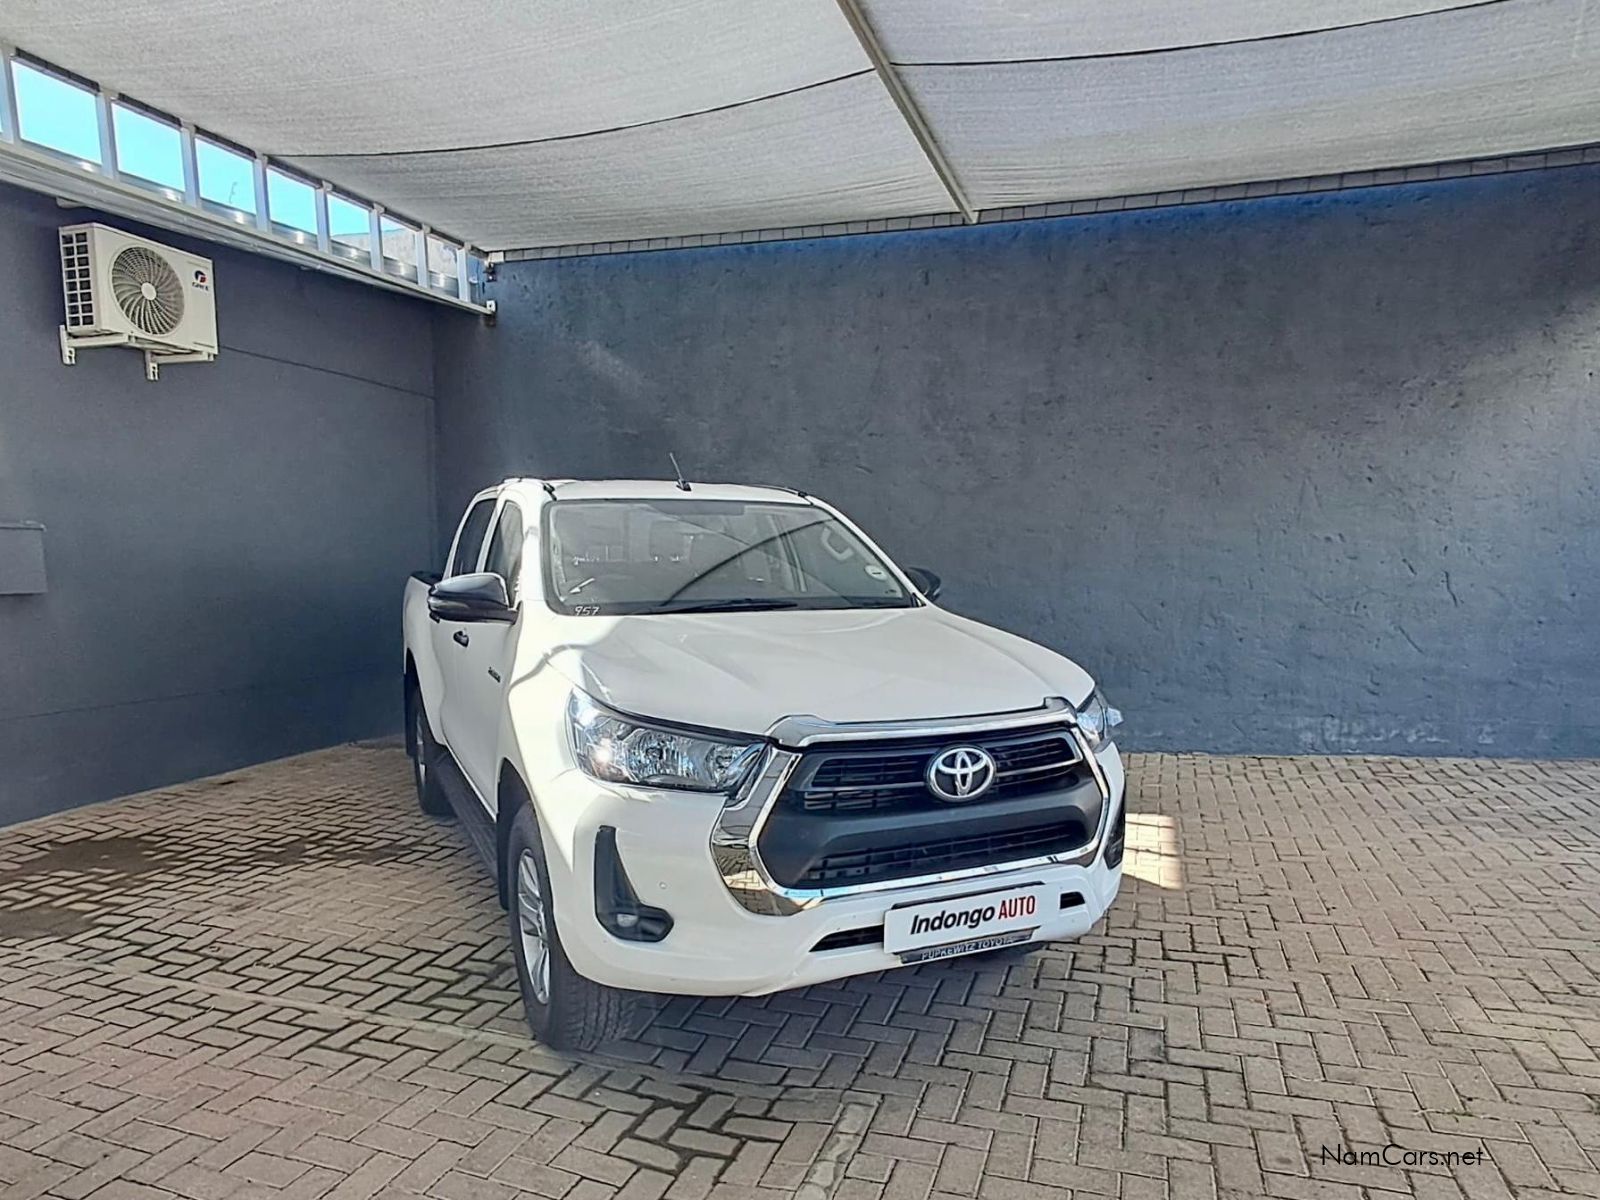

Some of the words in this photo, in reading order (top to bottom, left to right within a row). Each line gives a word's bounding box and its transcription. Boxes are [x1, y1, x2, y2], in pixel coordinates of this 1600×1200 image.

[575, 605, 600, 616] 957
[910, 906, 995, 935] Indongo
[998, 895, 1036, 920] AUTO
